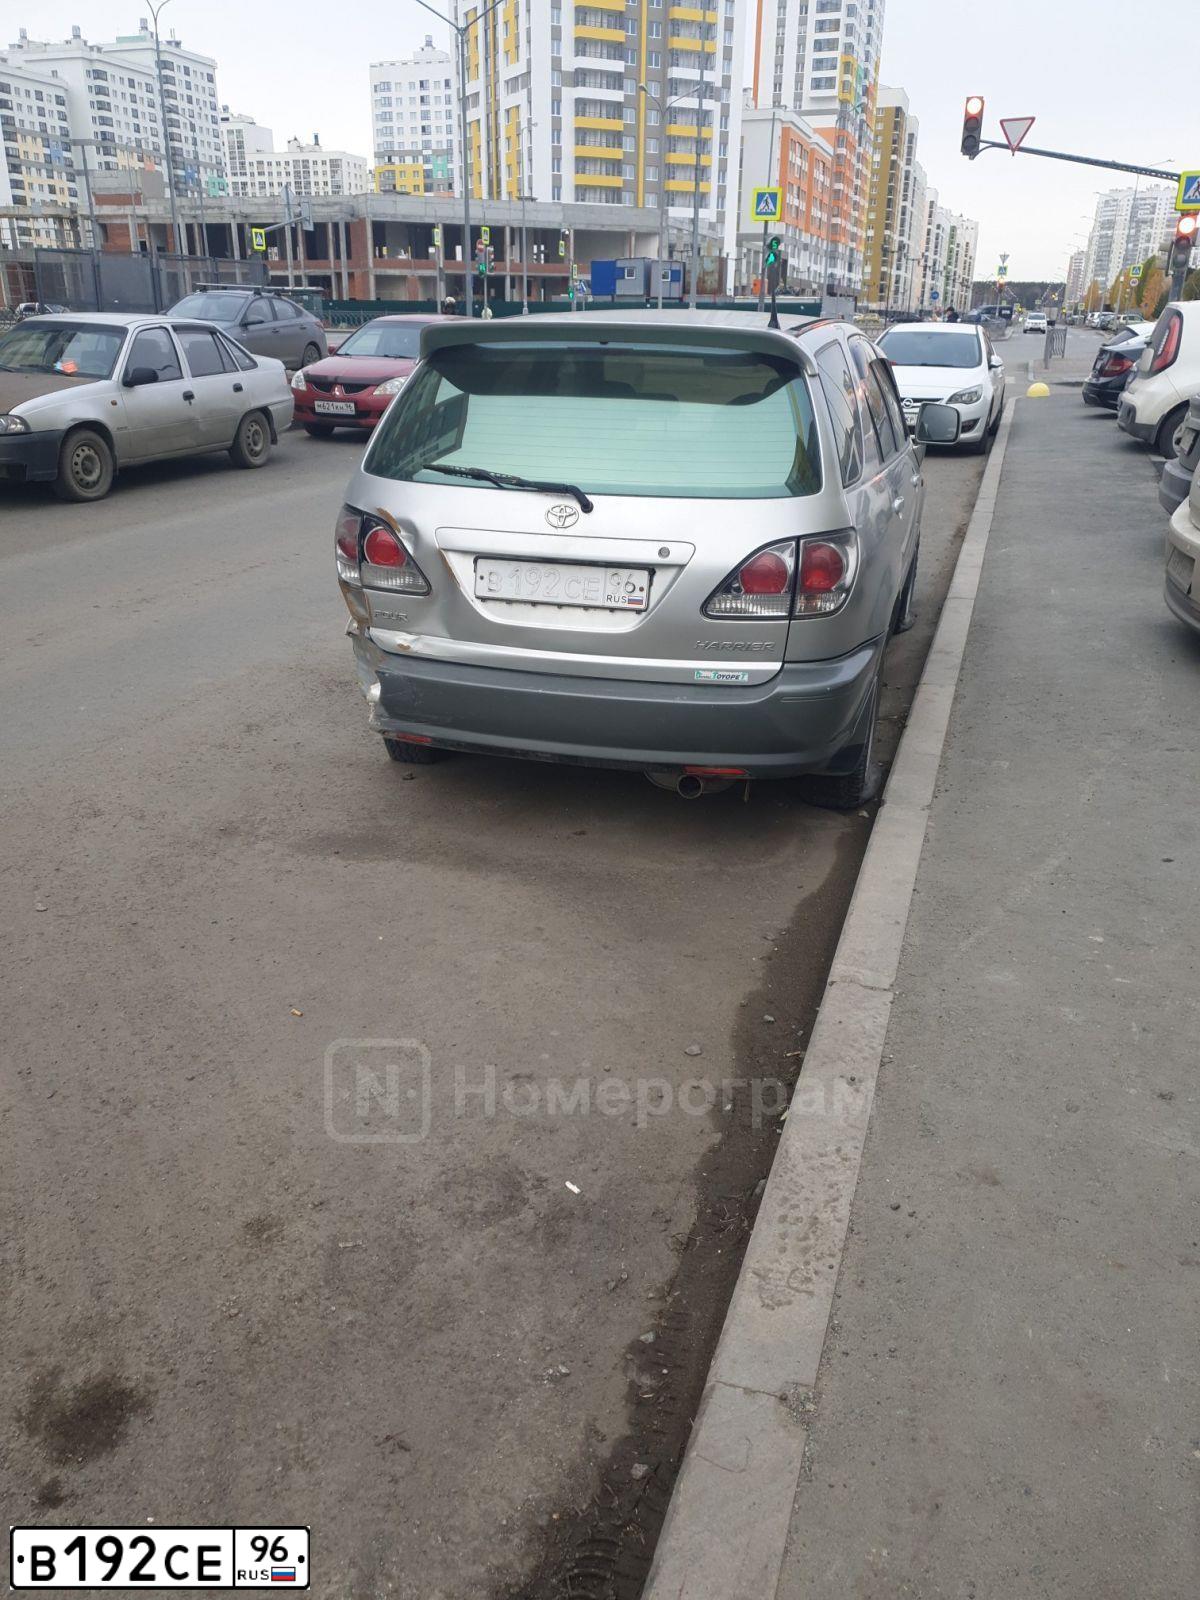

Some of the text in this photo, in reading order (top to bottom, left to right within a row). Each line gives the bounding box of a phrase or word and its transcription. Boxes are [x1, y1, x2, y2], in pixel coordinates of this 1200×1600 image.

[609, 572, 636, 594] 96
[606, 594, 627, 604] RUS
[694, 640, 776, 652] HARRIER
